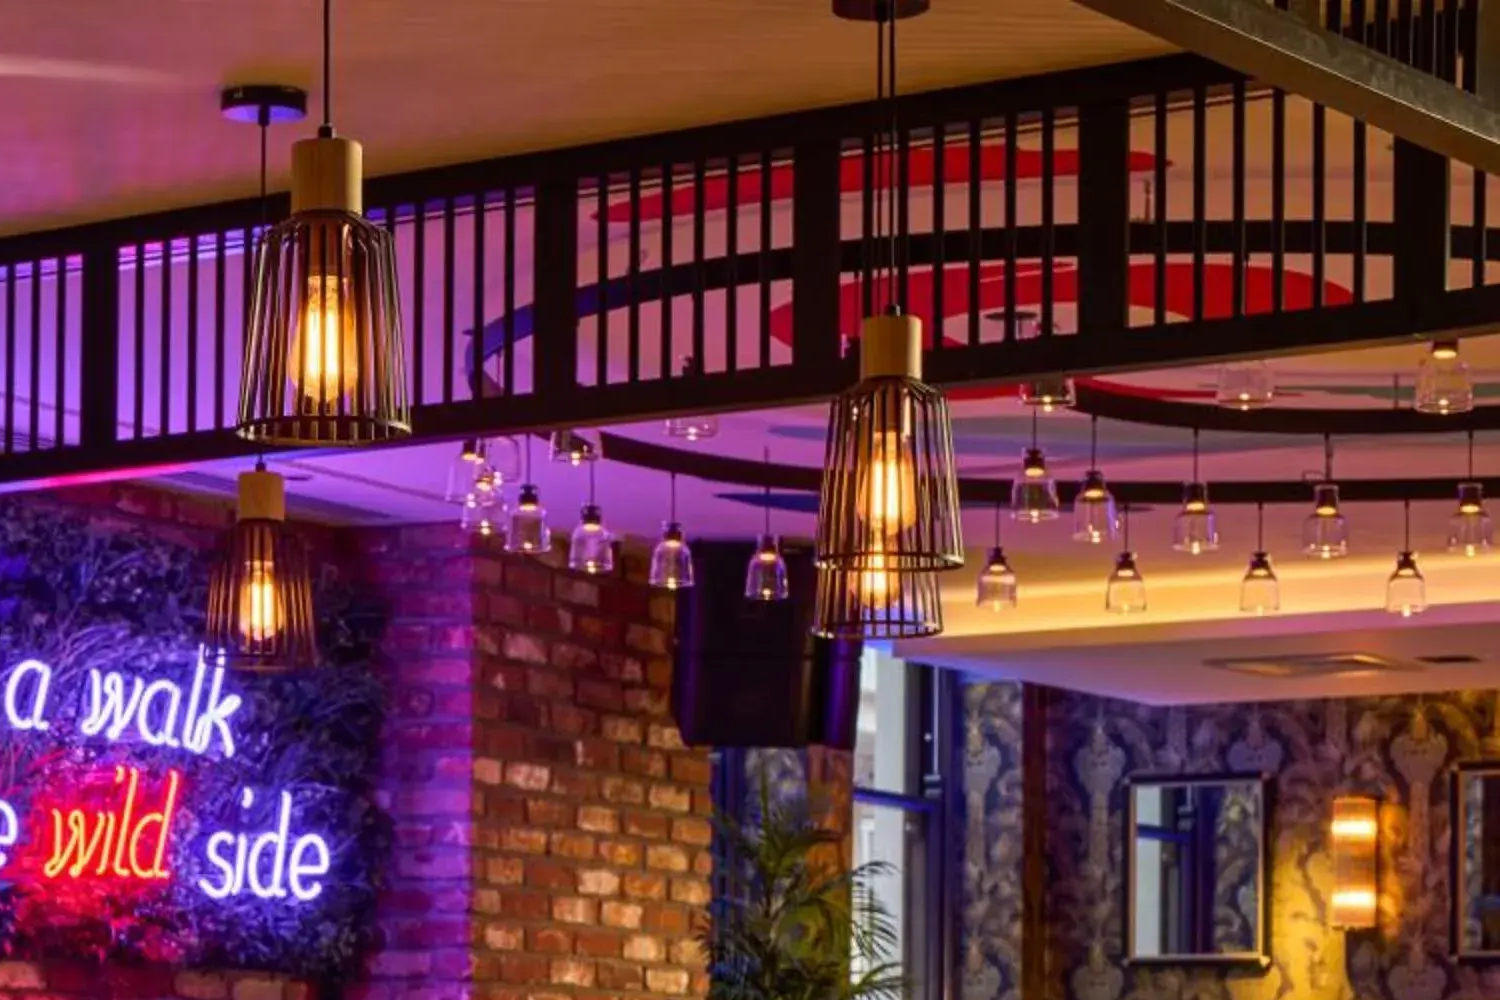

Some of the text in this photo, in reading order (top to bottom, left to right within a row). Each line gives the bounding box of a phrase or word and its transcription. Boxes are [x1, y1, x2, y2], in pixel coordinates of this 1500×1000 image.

[4, 659, 50, 730] a
[81, 643, 242, 758] walk
[43, 765, 178, 878] wild
[199, 786, 330, 901] side
